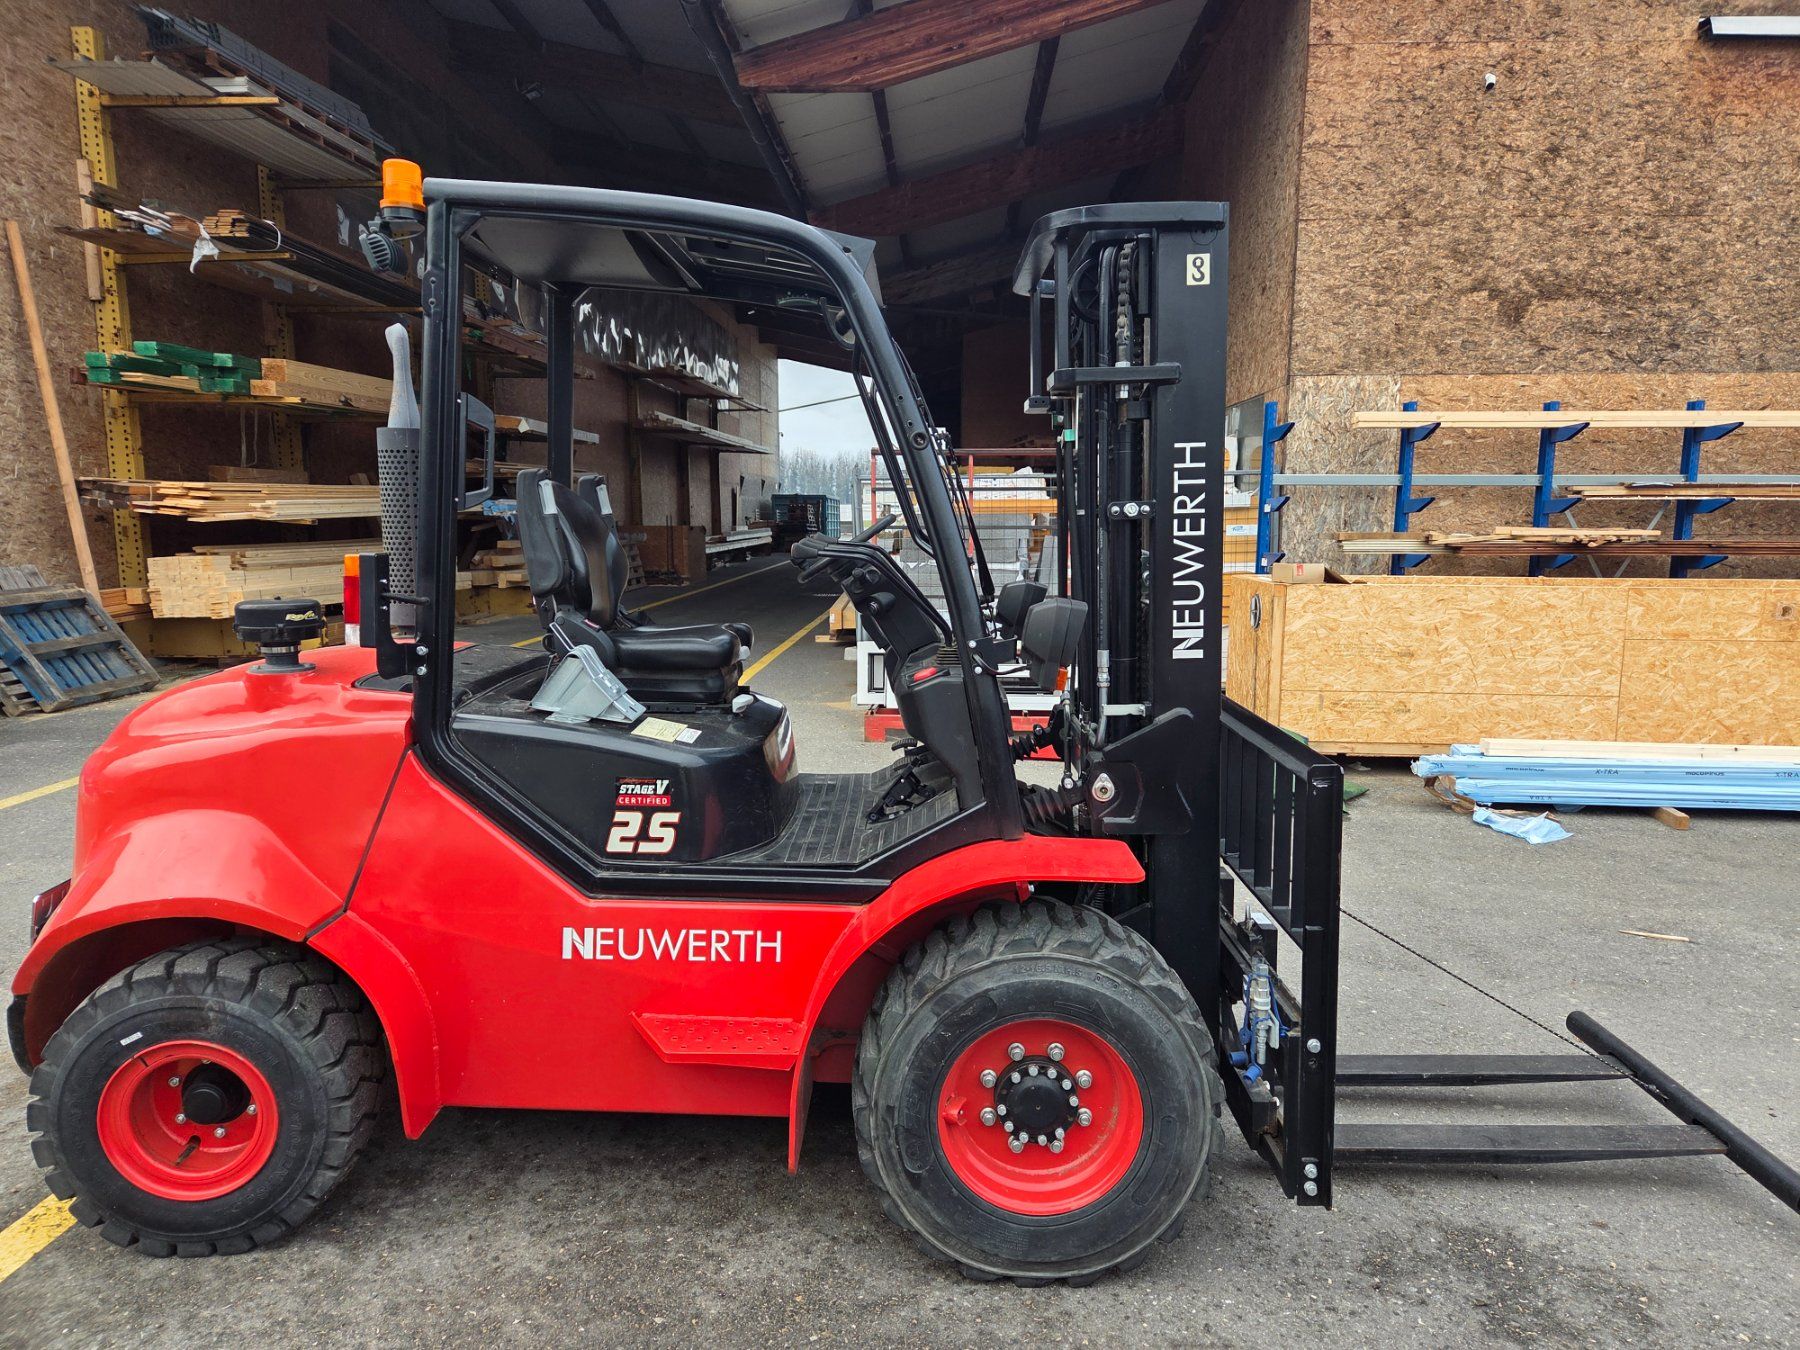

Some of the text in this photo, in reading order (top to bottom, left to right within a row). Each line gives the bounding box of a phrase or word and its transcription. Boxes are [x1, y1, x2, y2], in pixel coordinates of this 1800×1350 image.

[1172, 441, 1207, 660] NEUWERTH
[618, 784, 655, 795] STAGE
[655, 779, 669, 795] V
[618, 796, 668, 805] CERTIFIED
[561, 926, 783, 963] NEUWERTH
